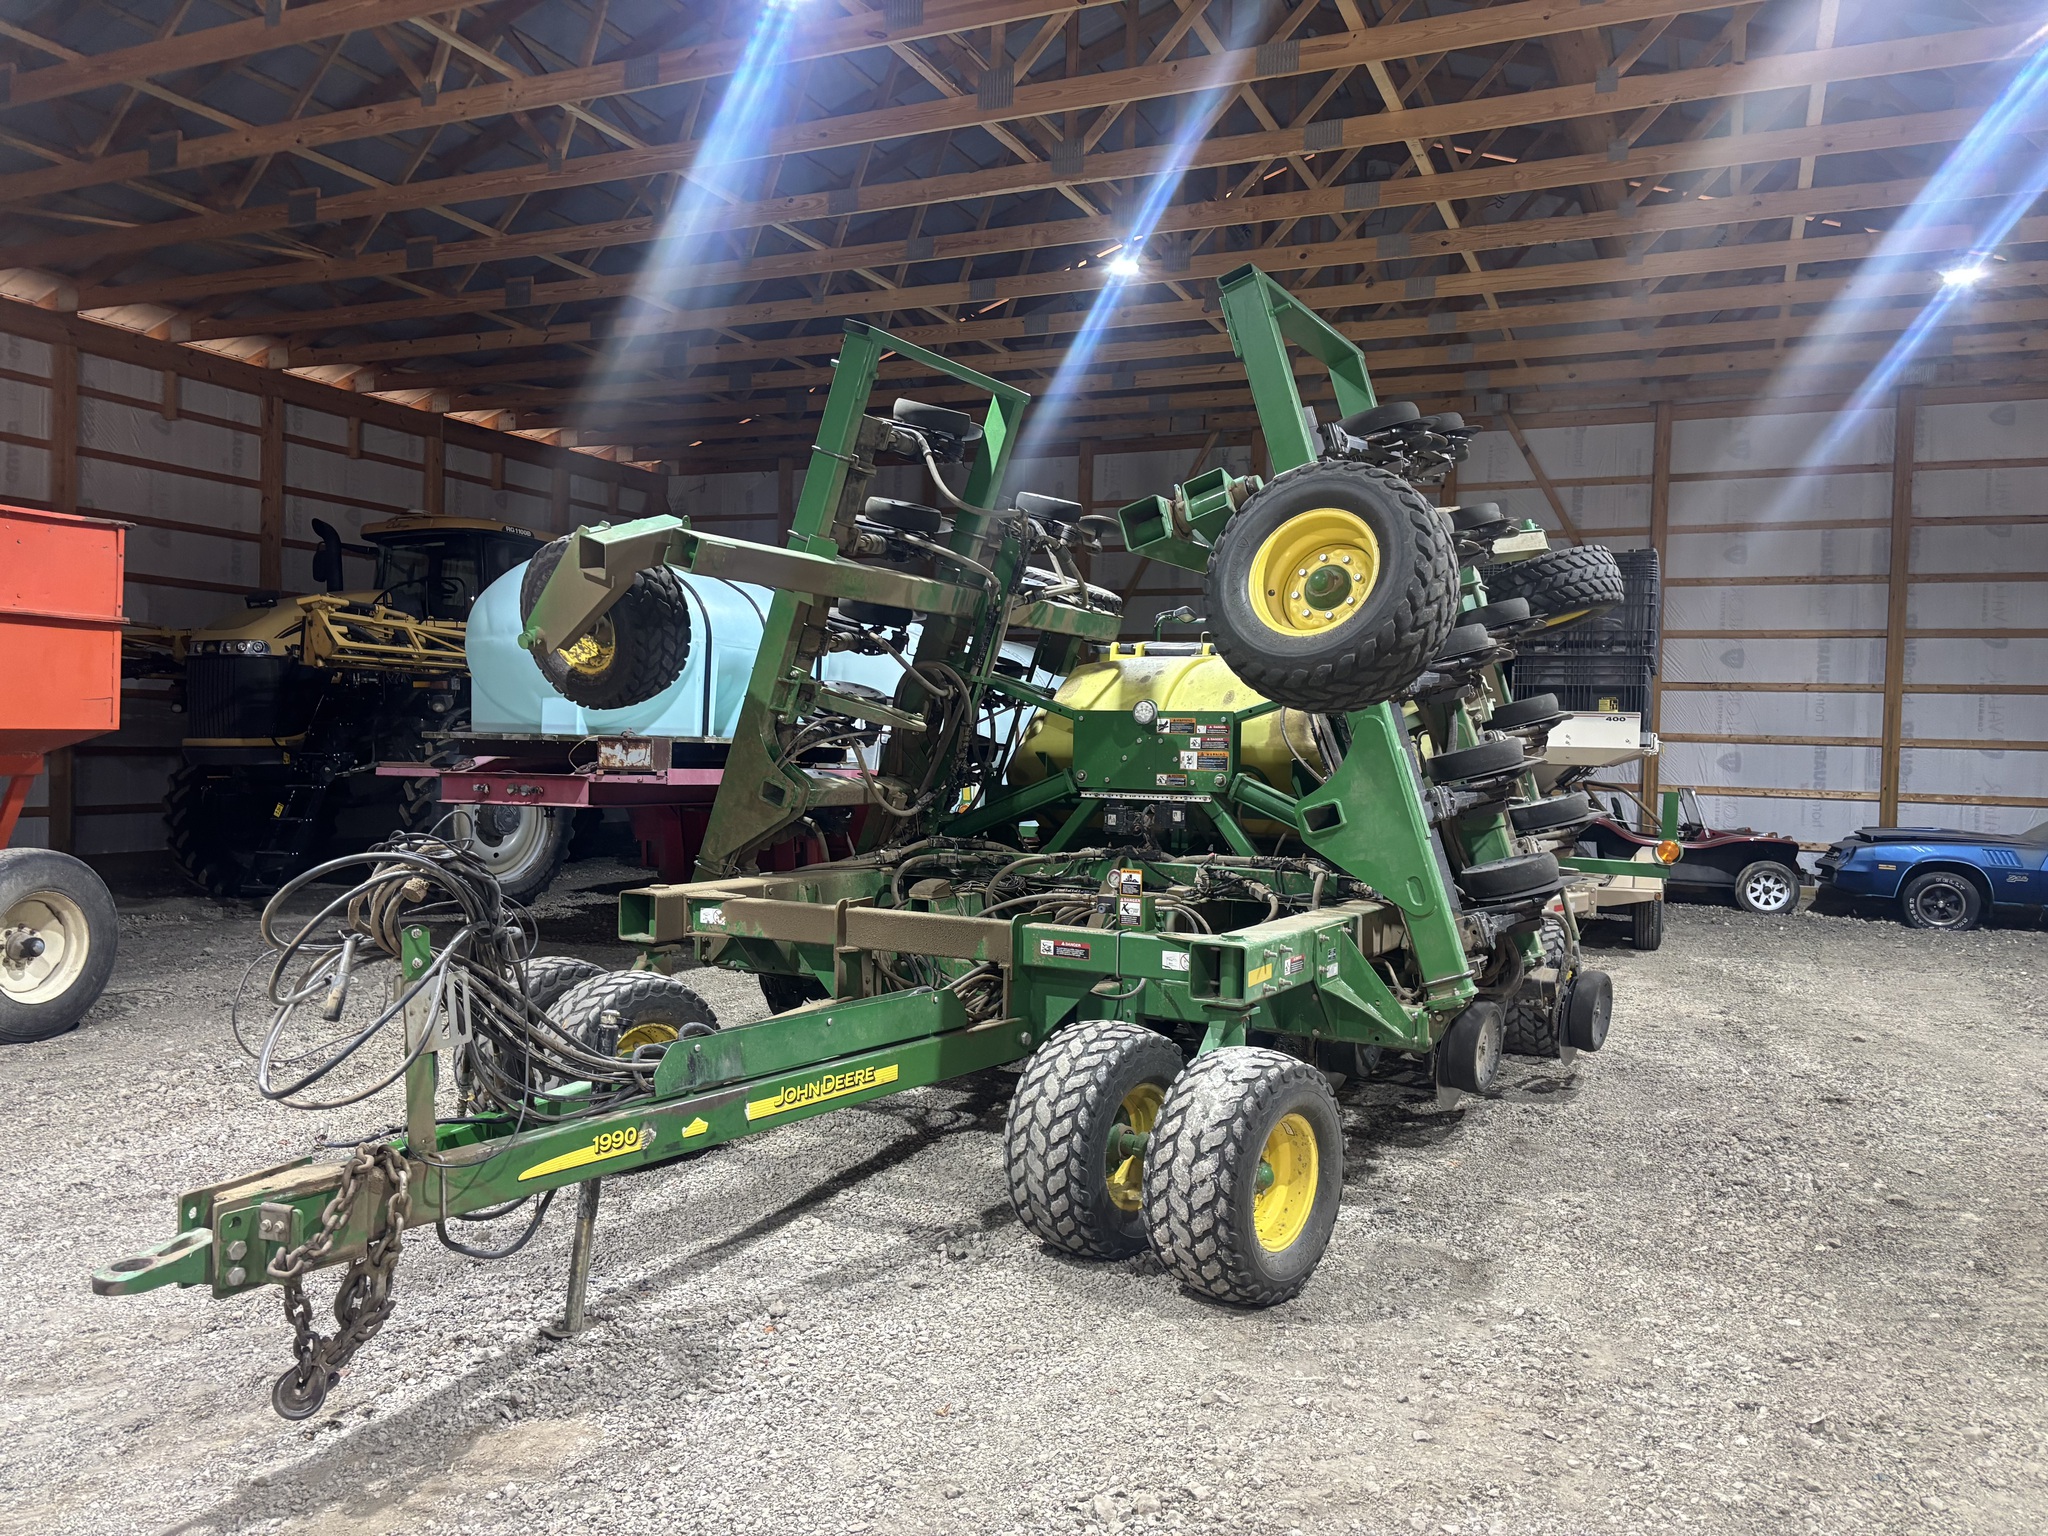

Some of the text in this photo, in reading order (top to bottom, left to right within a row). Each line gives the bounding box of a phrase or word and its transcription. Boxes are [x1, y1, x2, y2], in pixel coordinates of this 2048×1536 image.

[774, 1066, 876, 1108] JOHN DEERE
[592, 1125, 639, 1156] 1990
